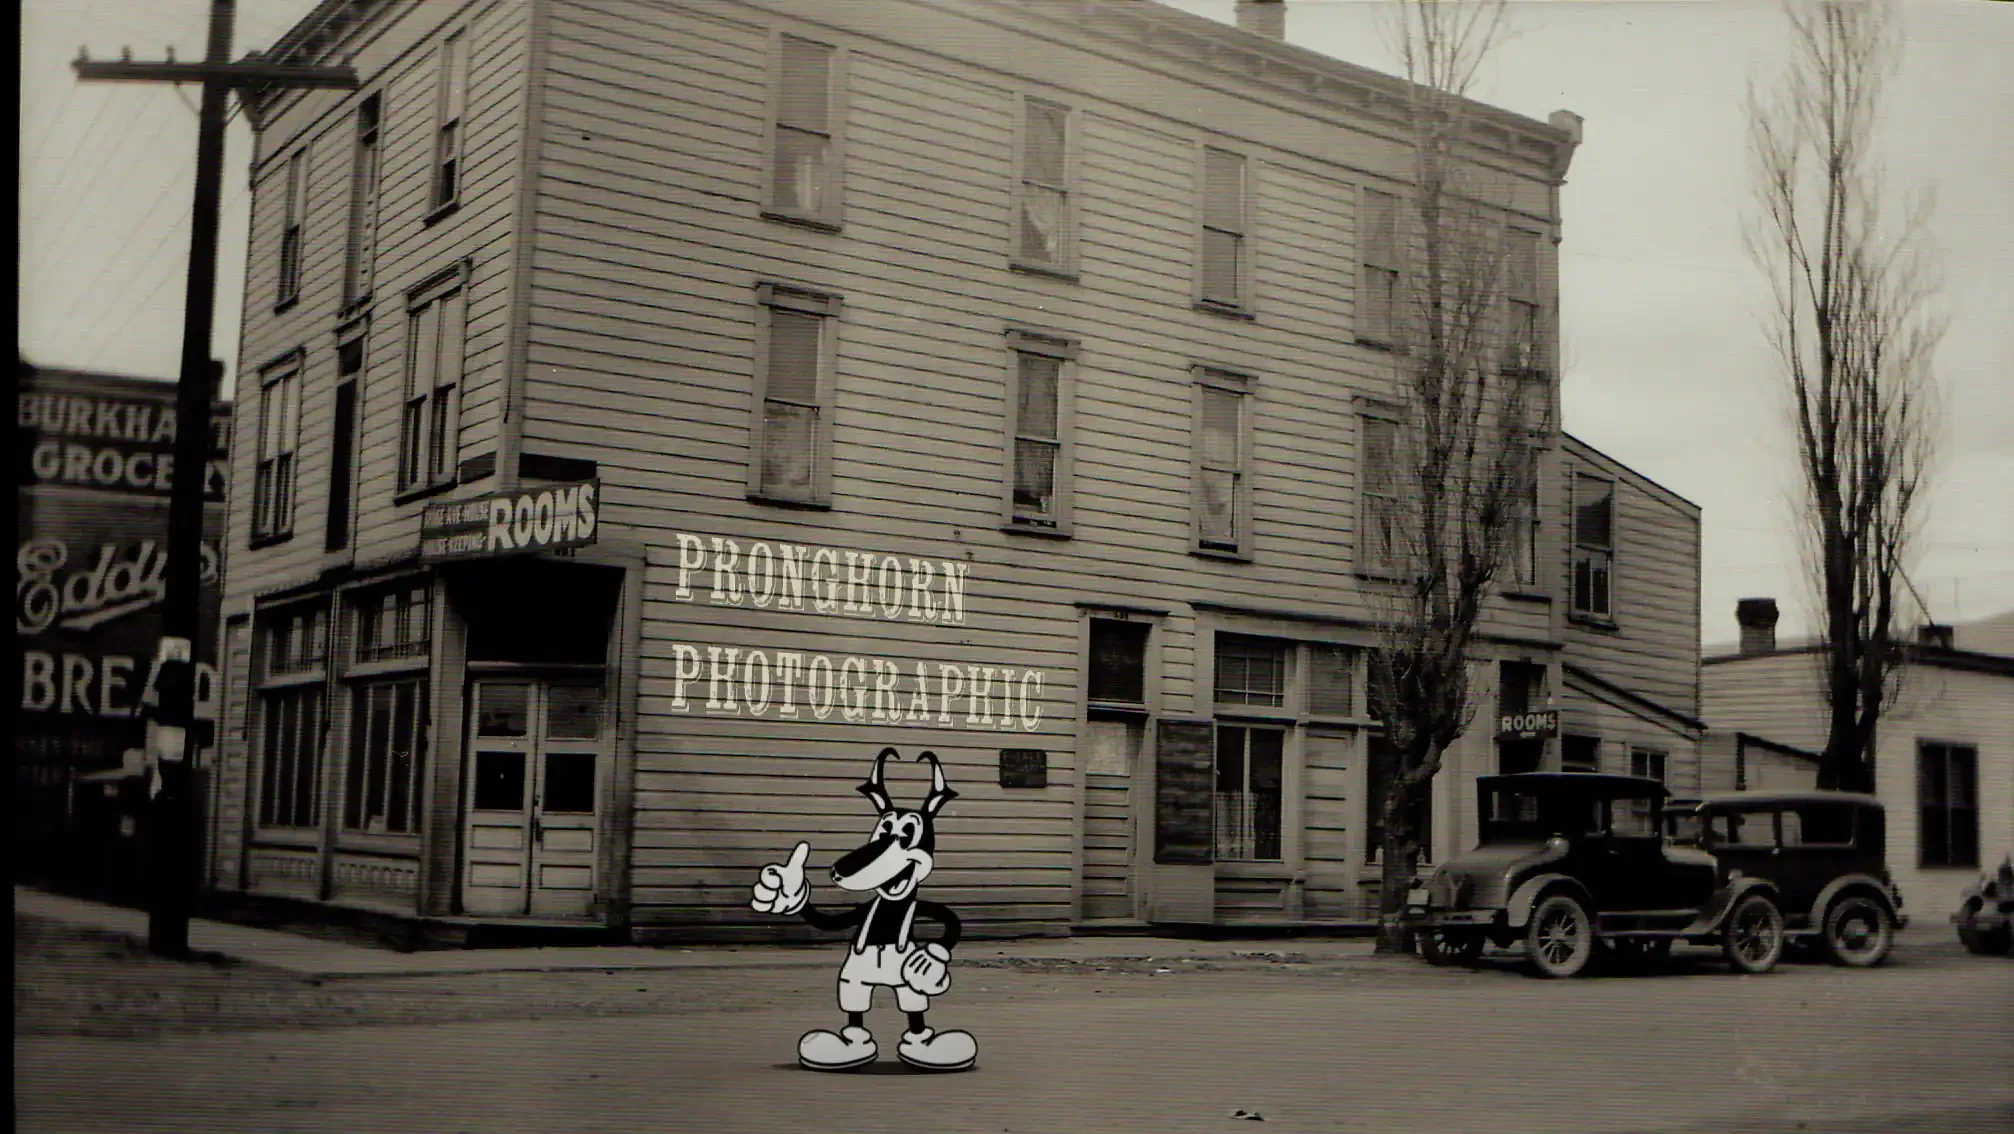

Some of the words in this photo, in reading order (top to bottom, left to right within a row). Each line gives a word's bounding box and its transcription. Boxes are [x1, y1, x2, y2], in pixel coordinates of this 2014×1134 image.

[18, 394, 231, 449] BURKHAT
[32, 440, 229, 495] GROCE
[488, 483, 596, 552] ROOMS
[675, 532, 970, 625] PRONGHORN
[671, 644, 1046, 732] PHOTOGRAPHIC
[1501, 712, 1556, 732] ROOMS
